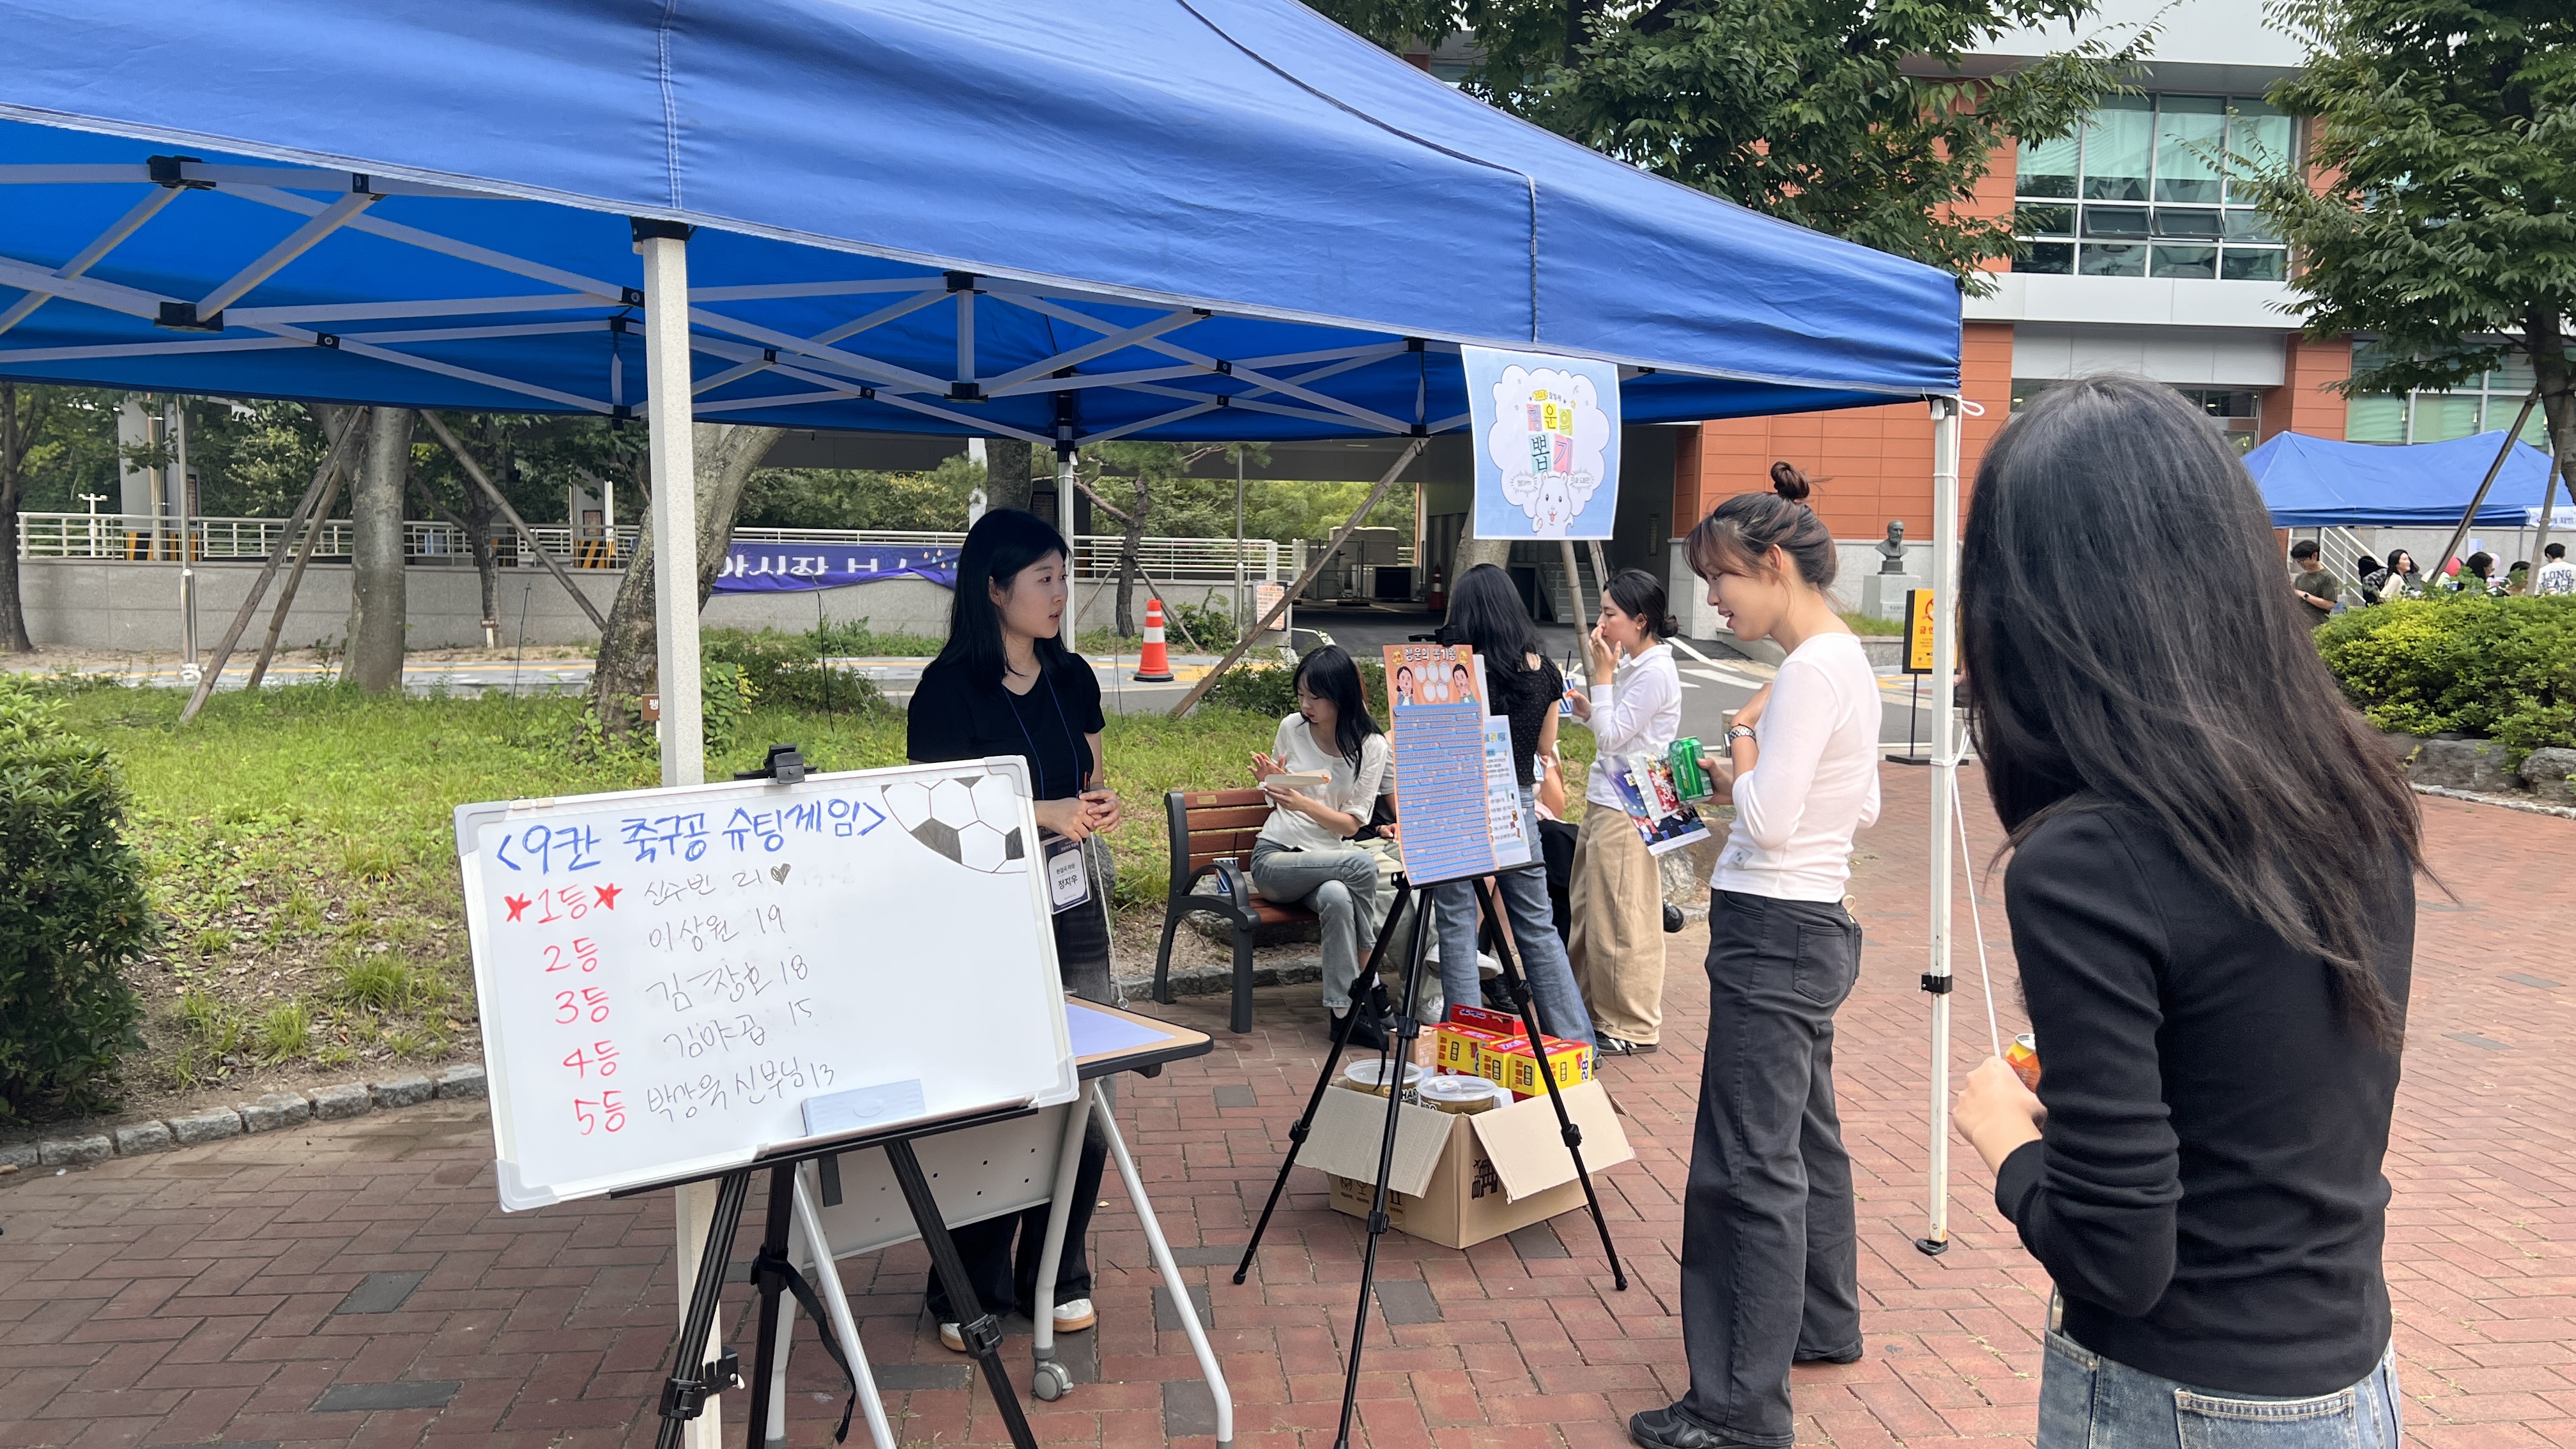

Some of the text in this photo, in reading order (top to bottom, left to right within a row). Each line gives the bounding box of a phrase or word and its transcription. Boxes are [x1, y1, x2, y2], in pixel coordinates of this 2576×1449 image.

[1527, 404, 1572, 436] 행운의
[1531, 434, 1572, 475] 뽑기
[2542, 569, 2572, 580] LONG
[1405, 647, 1430, 662] 행운의
[620, 811, 712, 864] 축구공
[538, 869, 763, 924] 1등 신수빈 21
[1058, 875, 1078, 890] 정지우
[543, 904, 787, 972] 2등 이상원 19
[555, 986, 610, 1024] 3등
[780, 954, 808, 985] 18
[562, 998, 812, 1079] 4등 김야곱 15
[1581, 1059, 1589, 1080] 28
[574, 1090, 626, 1136] 5등
[735, 1056, 804, 1105] 신부님
[809, 1062, 834, 1089] 13
